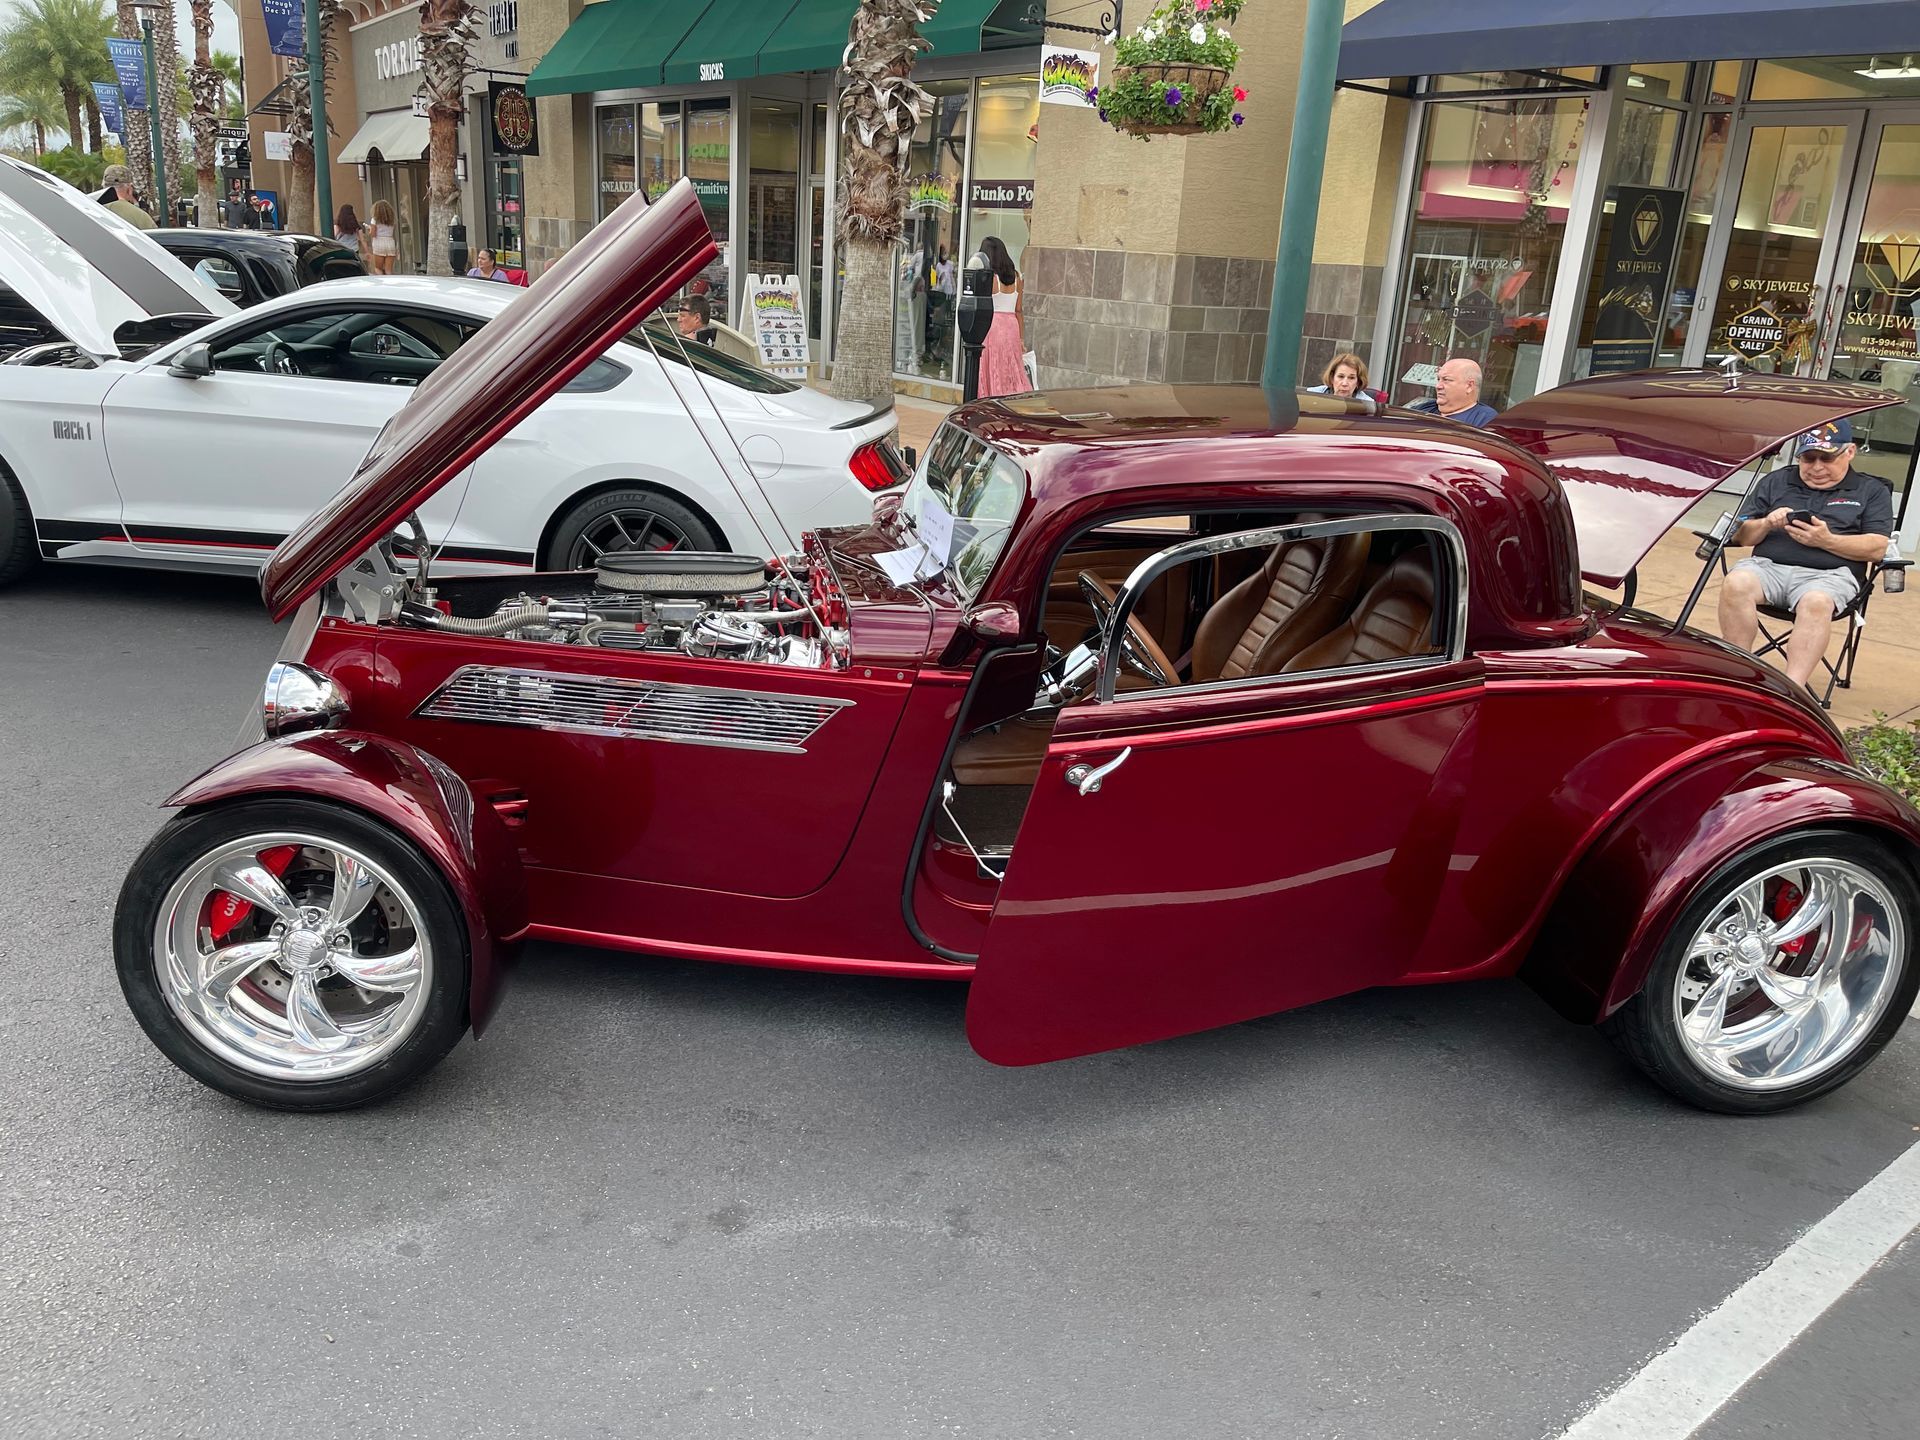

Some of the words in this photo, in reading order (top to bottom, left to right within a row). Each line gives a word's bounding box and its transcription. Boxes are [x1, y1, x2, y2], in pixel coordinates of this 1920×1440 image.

[265, 6, 279, 14] Dec
[110, 46, 142, 56] LIGHTS
[216, 128, 246, 137] ACIQUE
[691, 182, 728, 195] Primitive
[971, 185, 1015, 202] Funko
[1616, 260, 1633, 273] SKY
[1632, 262, 1662, 274] JEWELS
[1743, 279, 1765, 290] SKY
[1765, 280, 1810, 293] JEWELS
[1742, 316, 1773, 326] GRAND
[1846, 311, 1878, 326] SKY
[1728, 326, 1782, 340] OPENING
[1740, 341, 1765, 351] SALE!
[1860, 336, 1916, 349] 813-994-4111
[586, 493, 643, 513] MICHELIN
